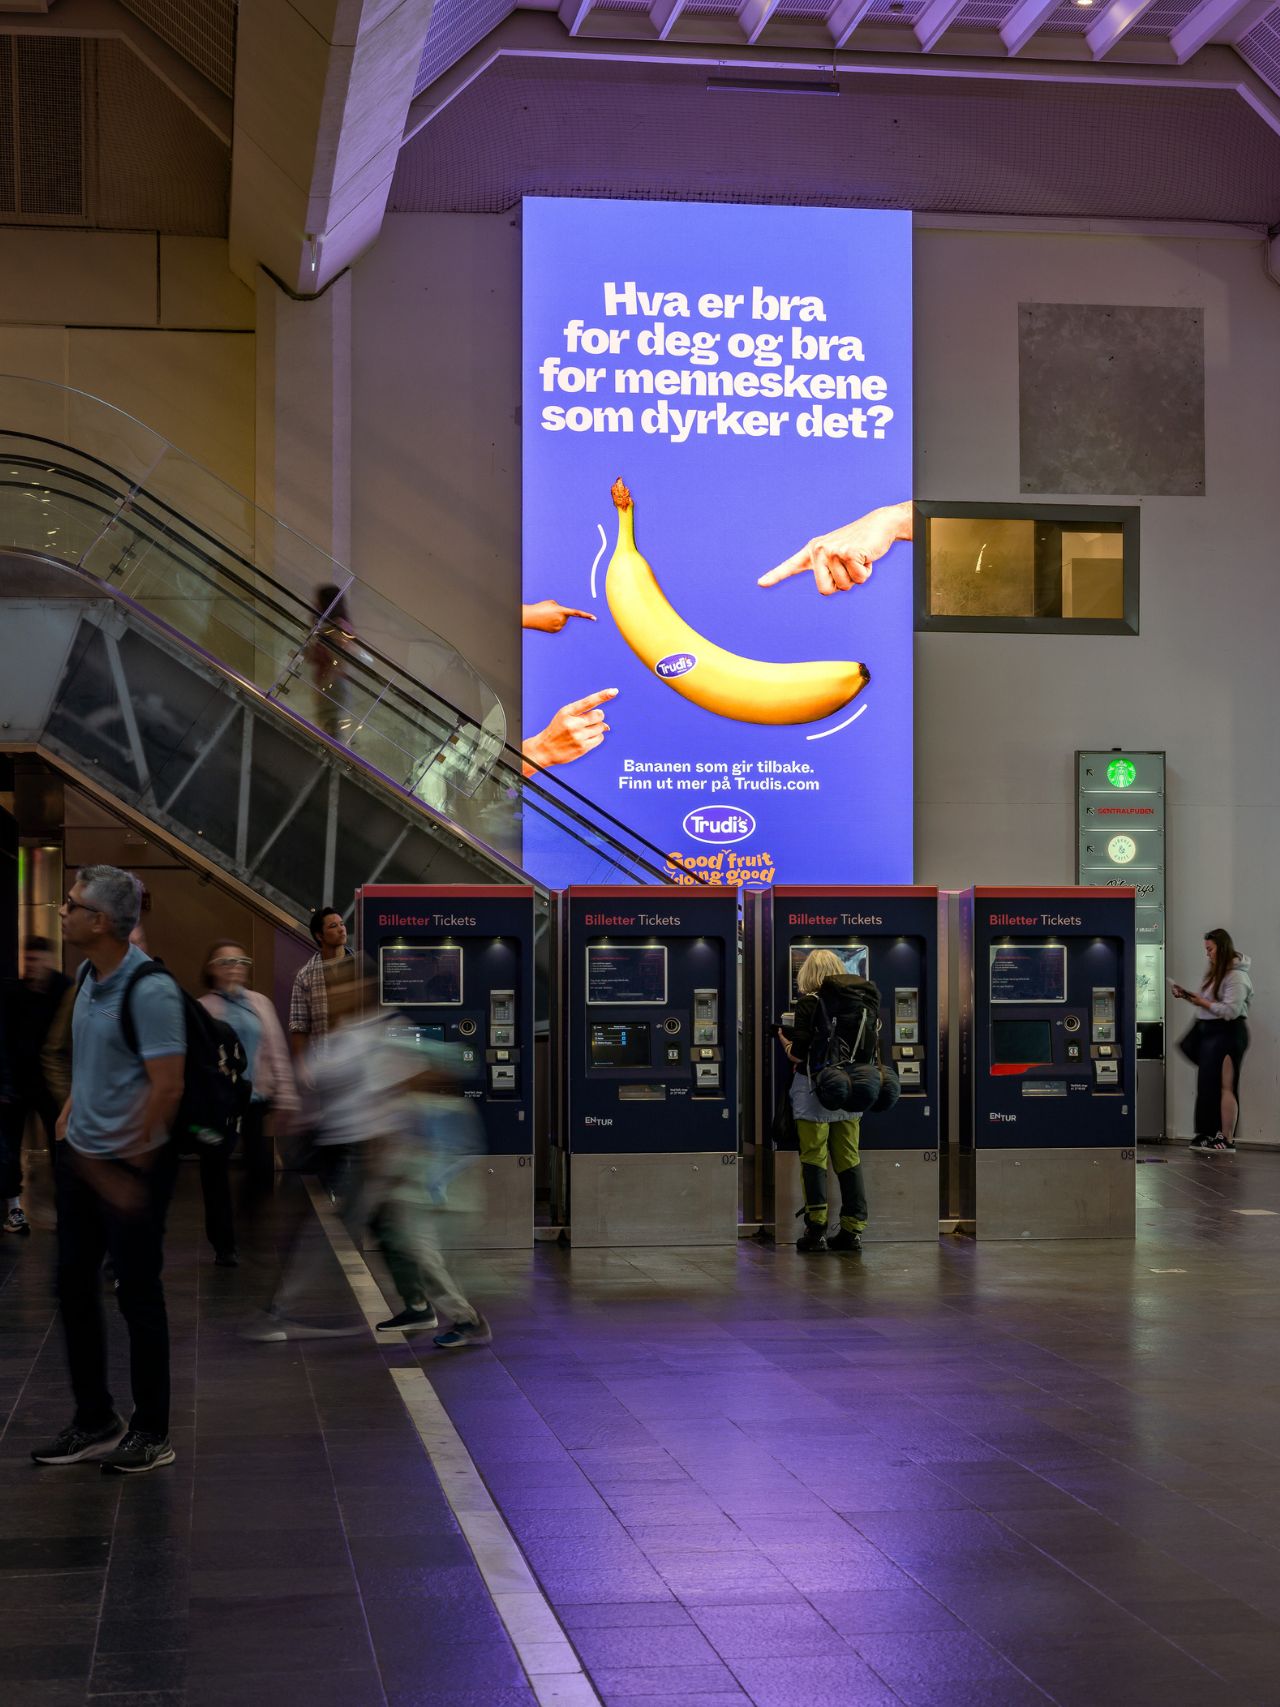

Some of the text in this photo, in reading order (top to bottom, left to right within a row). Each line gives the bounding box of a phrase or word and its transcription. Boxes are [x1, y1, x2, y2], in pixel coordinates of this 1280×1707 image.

[603, 281, 827, 322] Hva er bra
[563, 319, 865, 367] for deg og bra
[539, 357, 888, 401] for menneskene
[541, 400, 894, 443] som dyrker det?
[623, 759, 814, 776] Bananen som gir tilbake.
[618, 775, 820, 793] Finn ut mer på Trudis.com
[666, 852, 775, 870] Good fruit
[726, 867, 777, 888] good
[379, 914, 477, 926] Billetter Tickets
[585, 914, 681, 926] Billetter Tickets
[788, 913, 883, 925] Billetter Tickets
[989, 914, 1082, 926] Billetter Tickets
[518, 1156, 532, 1168] 01
[722, 1154, 736, 1165] 02
[923, 1151, 937, 1162] 03
[1121, 1149, 1135, 1161] 09
